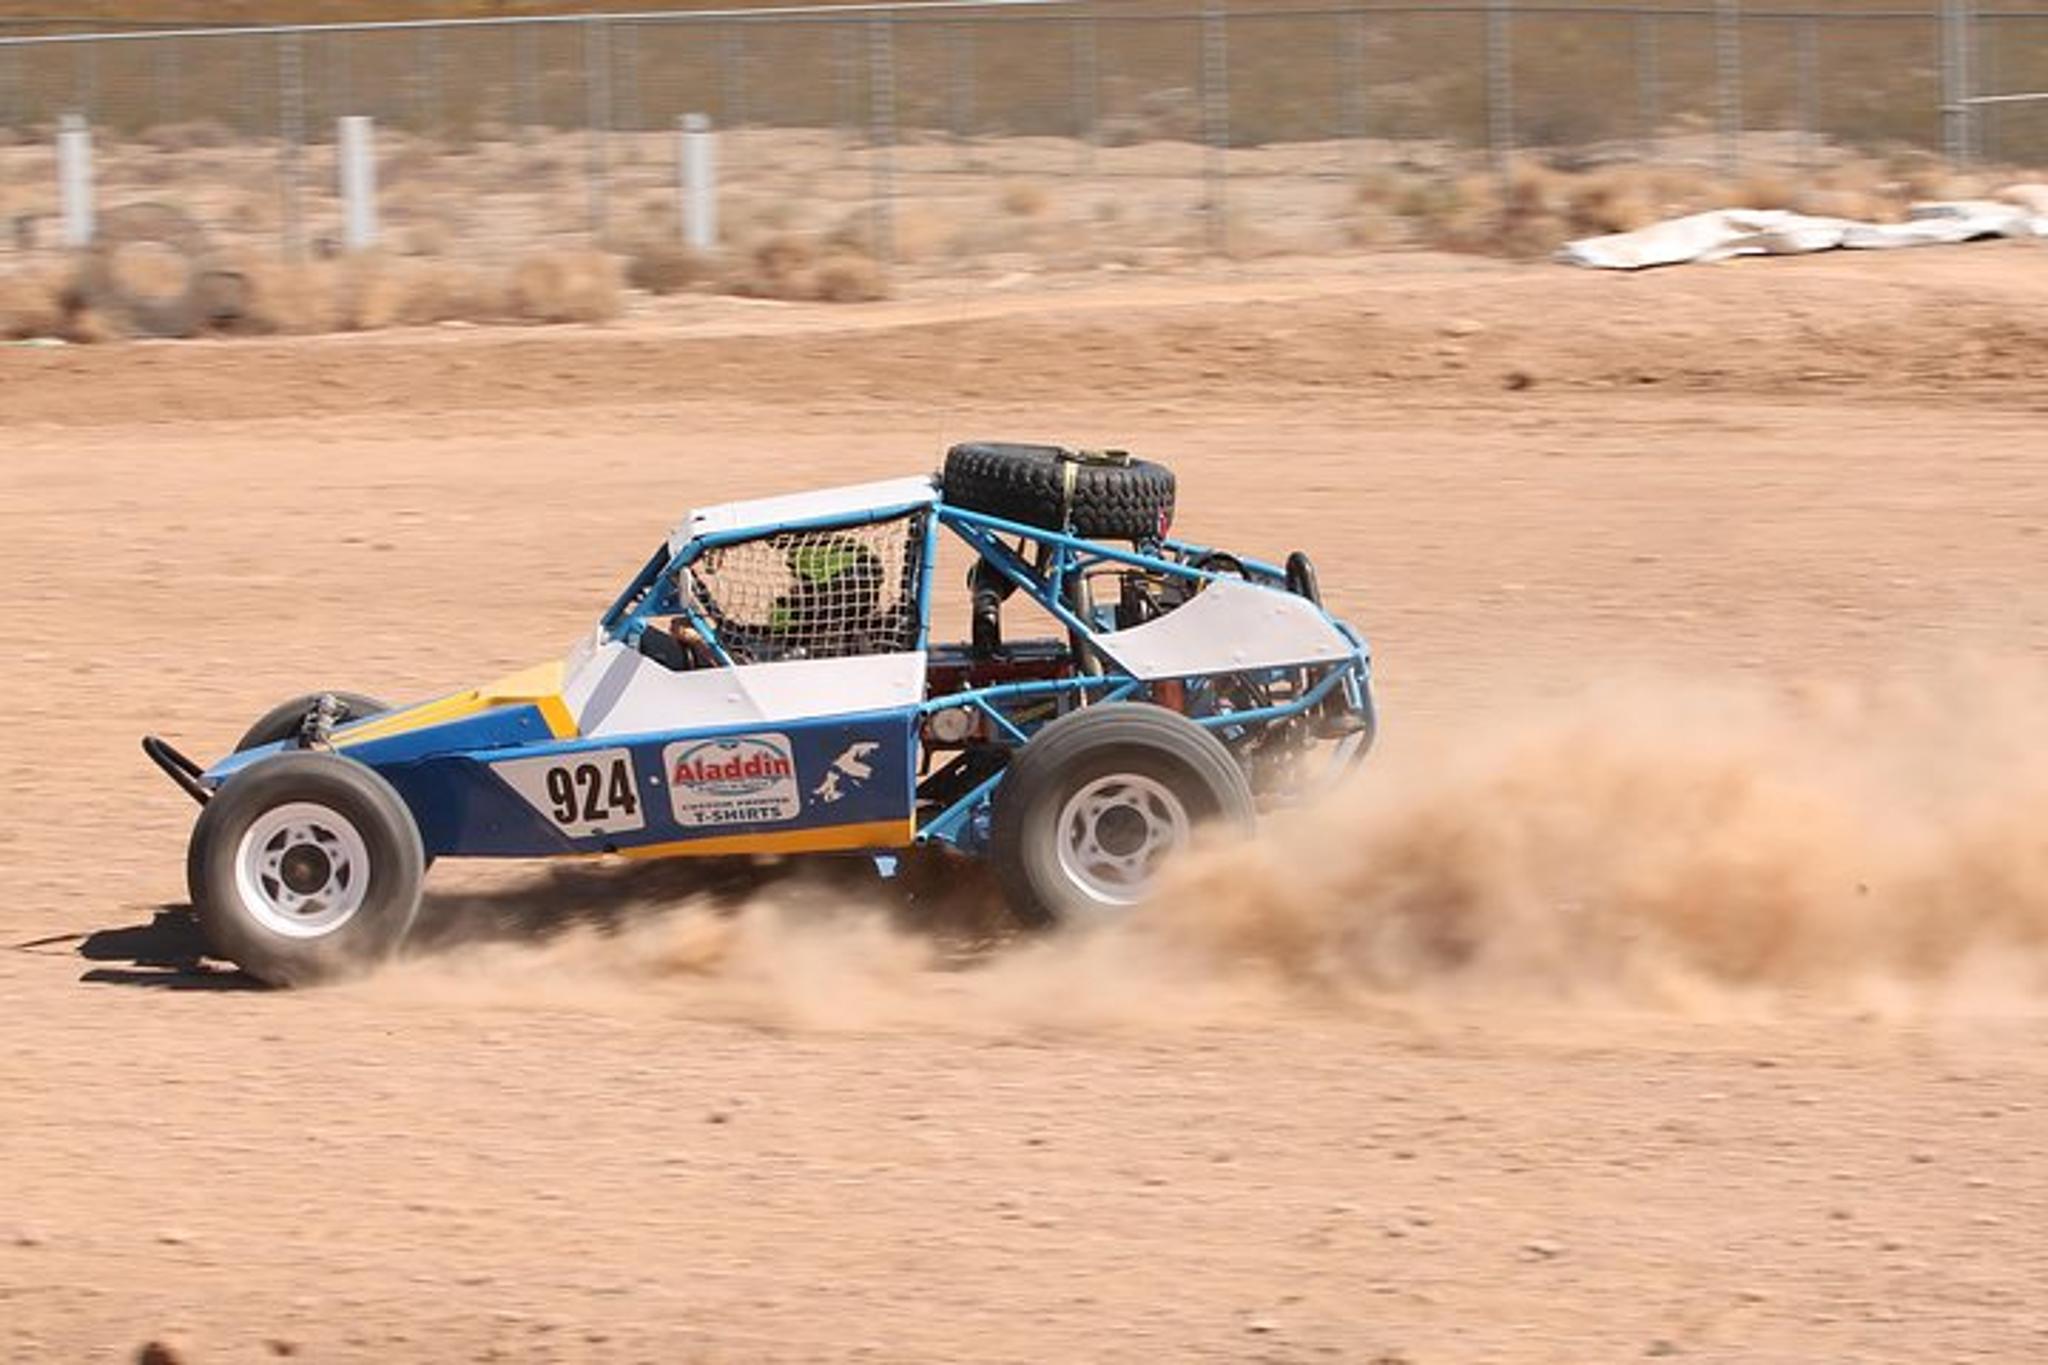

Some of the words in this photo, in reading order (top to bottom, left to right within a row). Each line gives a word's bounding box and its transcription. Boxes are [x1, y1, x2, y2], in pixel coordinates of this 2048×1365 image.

[674, 752, 790, 784] Aladdin
[547, 759, 636, 824] 924
[694, 807, 782, 822] T-SHIRTS
